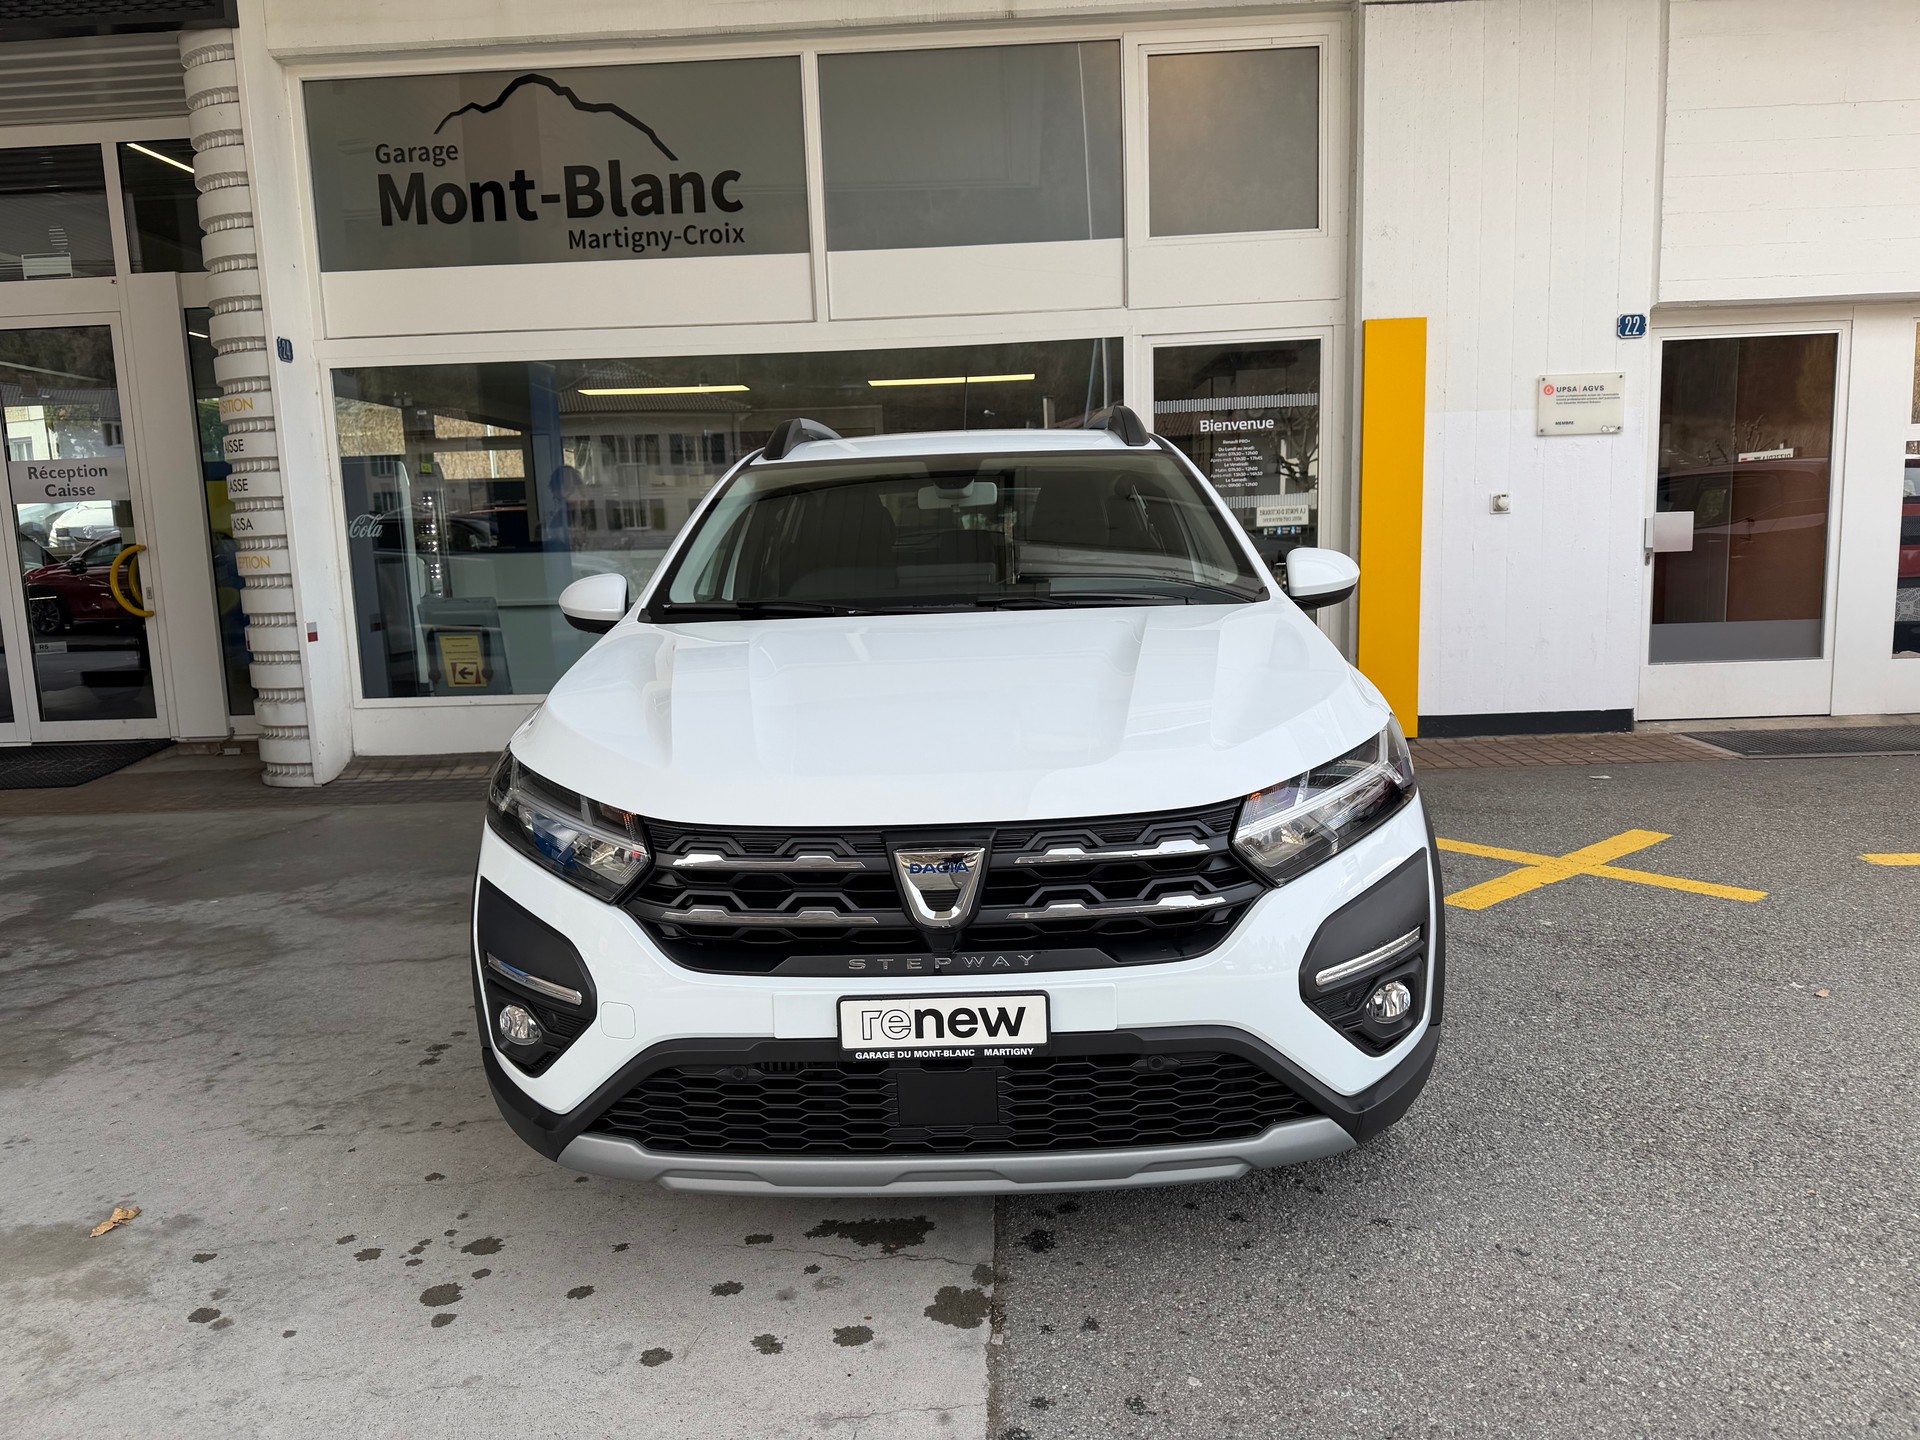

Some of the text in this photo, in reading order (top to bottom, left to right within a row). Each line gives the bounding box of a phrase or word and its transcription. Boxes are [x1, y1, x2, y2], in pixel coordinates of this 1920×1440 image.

[375, 143, 459, 167] Garage
[377, 159, 744, 226] Mont-Blanc
[568, 222, 745, 252] Martigny-Croix
[1625, 316, 1640, 335] 22
[1200, 419, 1274, 432] Bienvenue
[27, 464, 108, 482] Réception
[45, 484, 96, 497] Caisse
[232, 518, 254, 531] ASSA
[909, 862, 970, 874] DACIA
[848, 954, 1034, 970] STEPWAY
[861, 1006, 1026, 1041] renew
[855, 1048, 1034, 1059] GARAGE DU MONT-BLANC MARTIGNY
